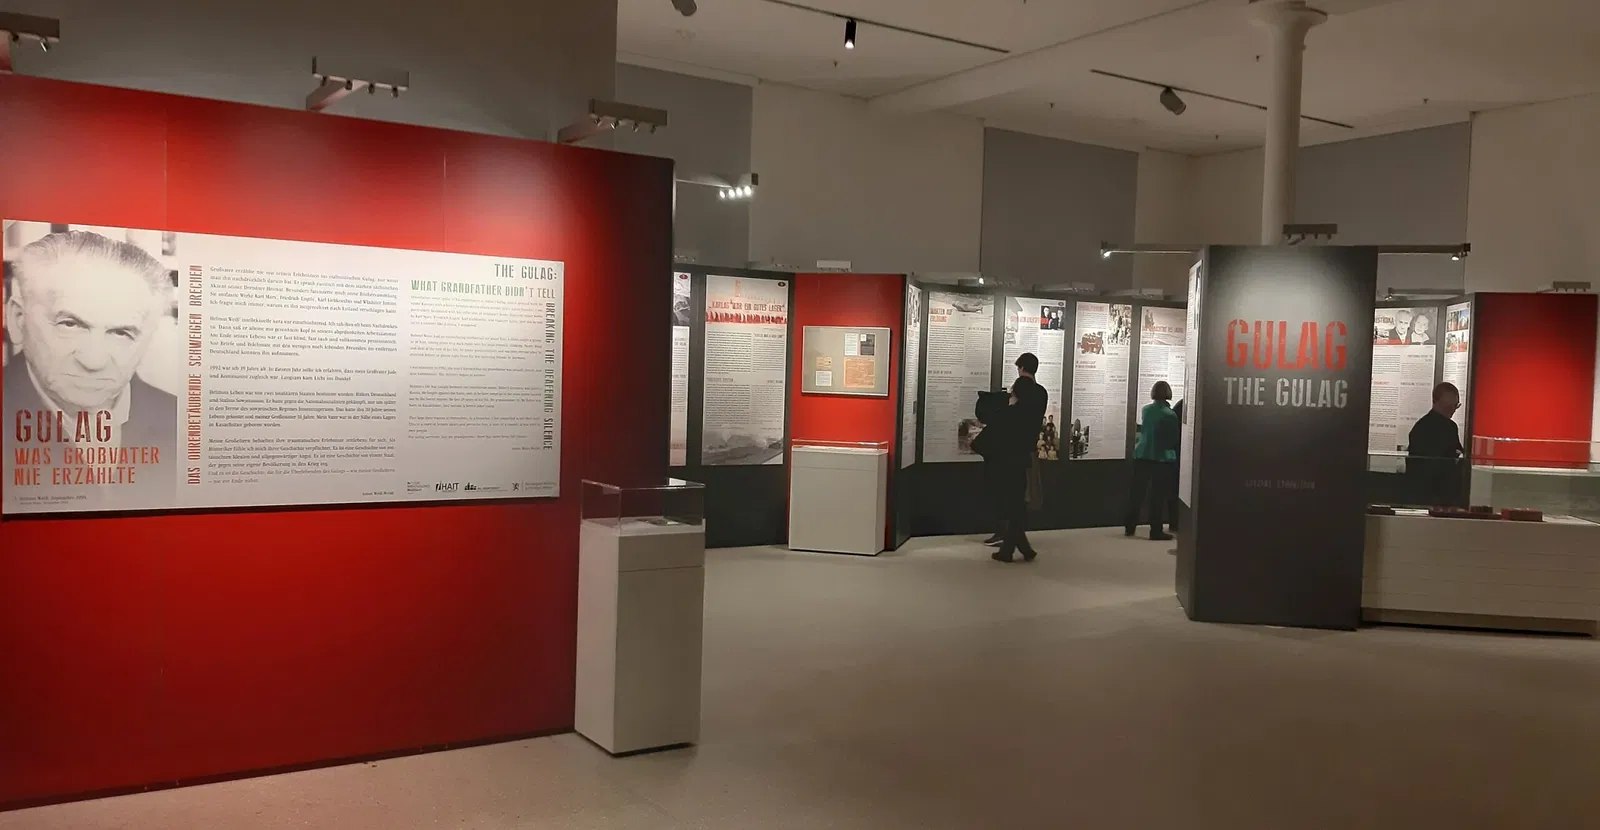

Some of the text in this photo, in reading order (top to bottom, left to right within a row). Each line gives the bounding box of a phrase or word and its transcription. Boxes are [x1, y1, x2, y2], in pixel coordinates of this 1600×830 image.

[494, 263, 557, 281] THE GULAG:
[411, 279, 556, 299] WHAT GRANDFATHER DIDN'T TELL
[1226, 318, 1348, 371] GULAG
[186, 264, 203, 485] DAS OHRENBETÄUBENDE SCHWEIGEN BRECHEN
[542, 301, 556, 450] BREAKING THE DEAFENING SILENCE
[1223, 377, 1266, 406] THE
[1275, 378, 1348, 409] GULAG
[15, 409, 112, 443] GULAG
[15, 447, 53, 466] WAS
[14, 465, 136, 486] NIE ERZÄHLTE
